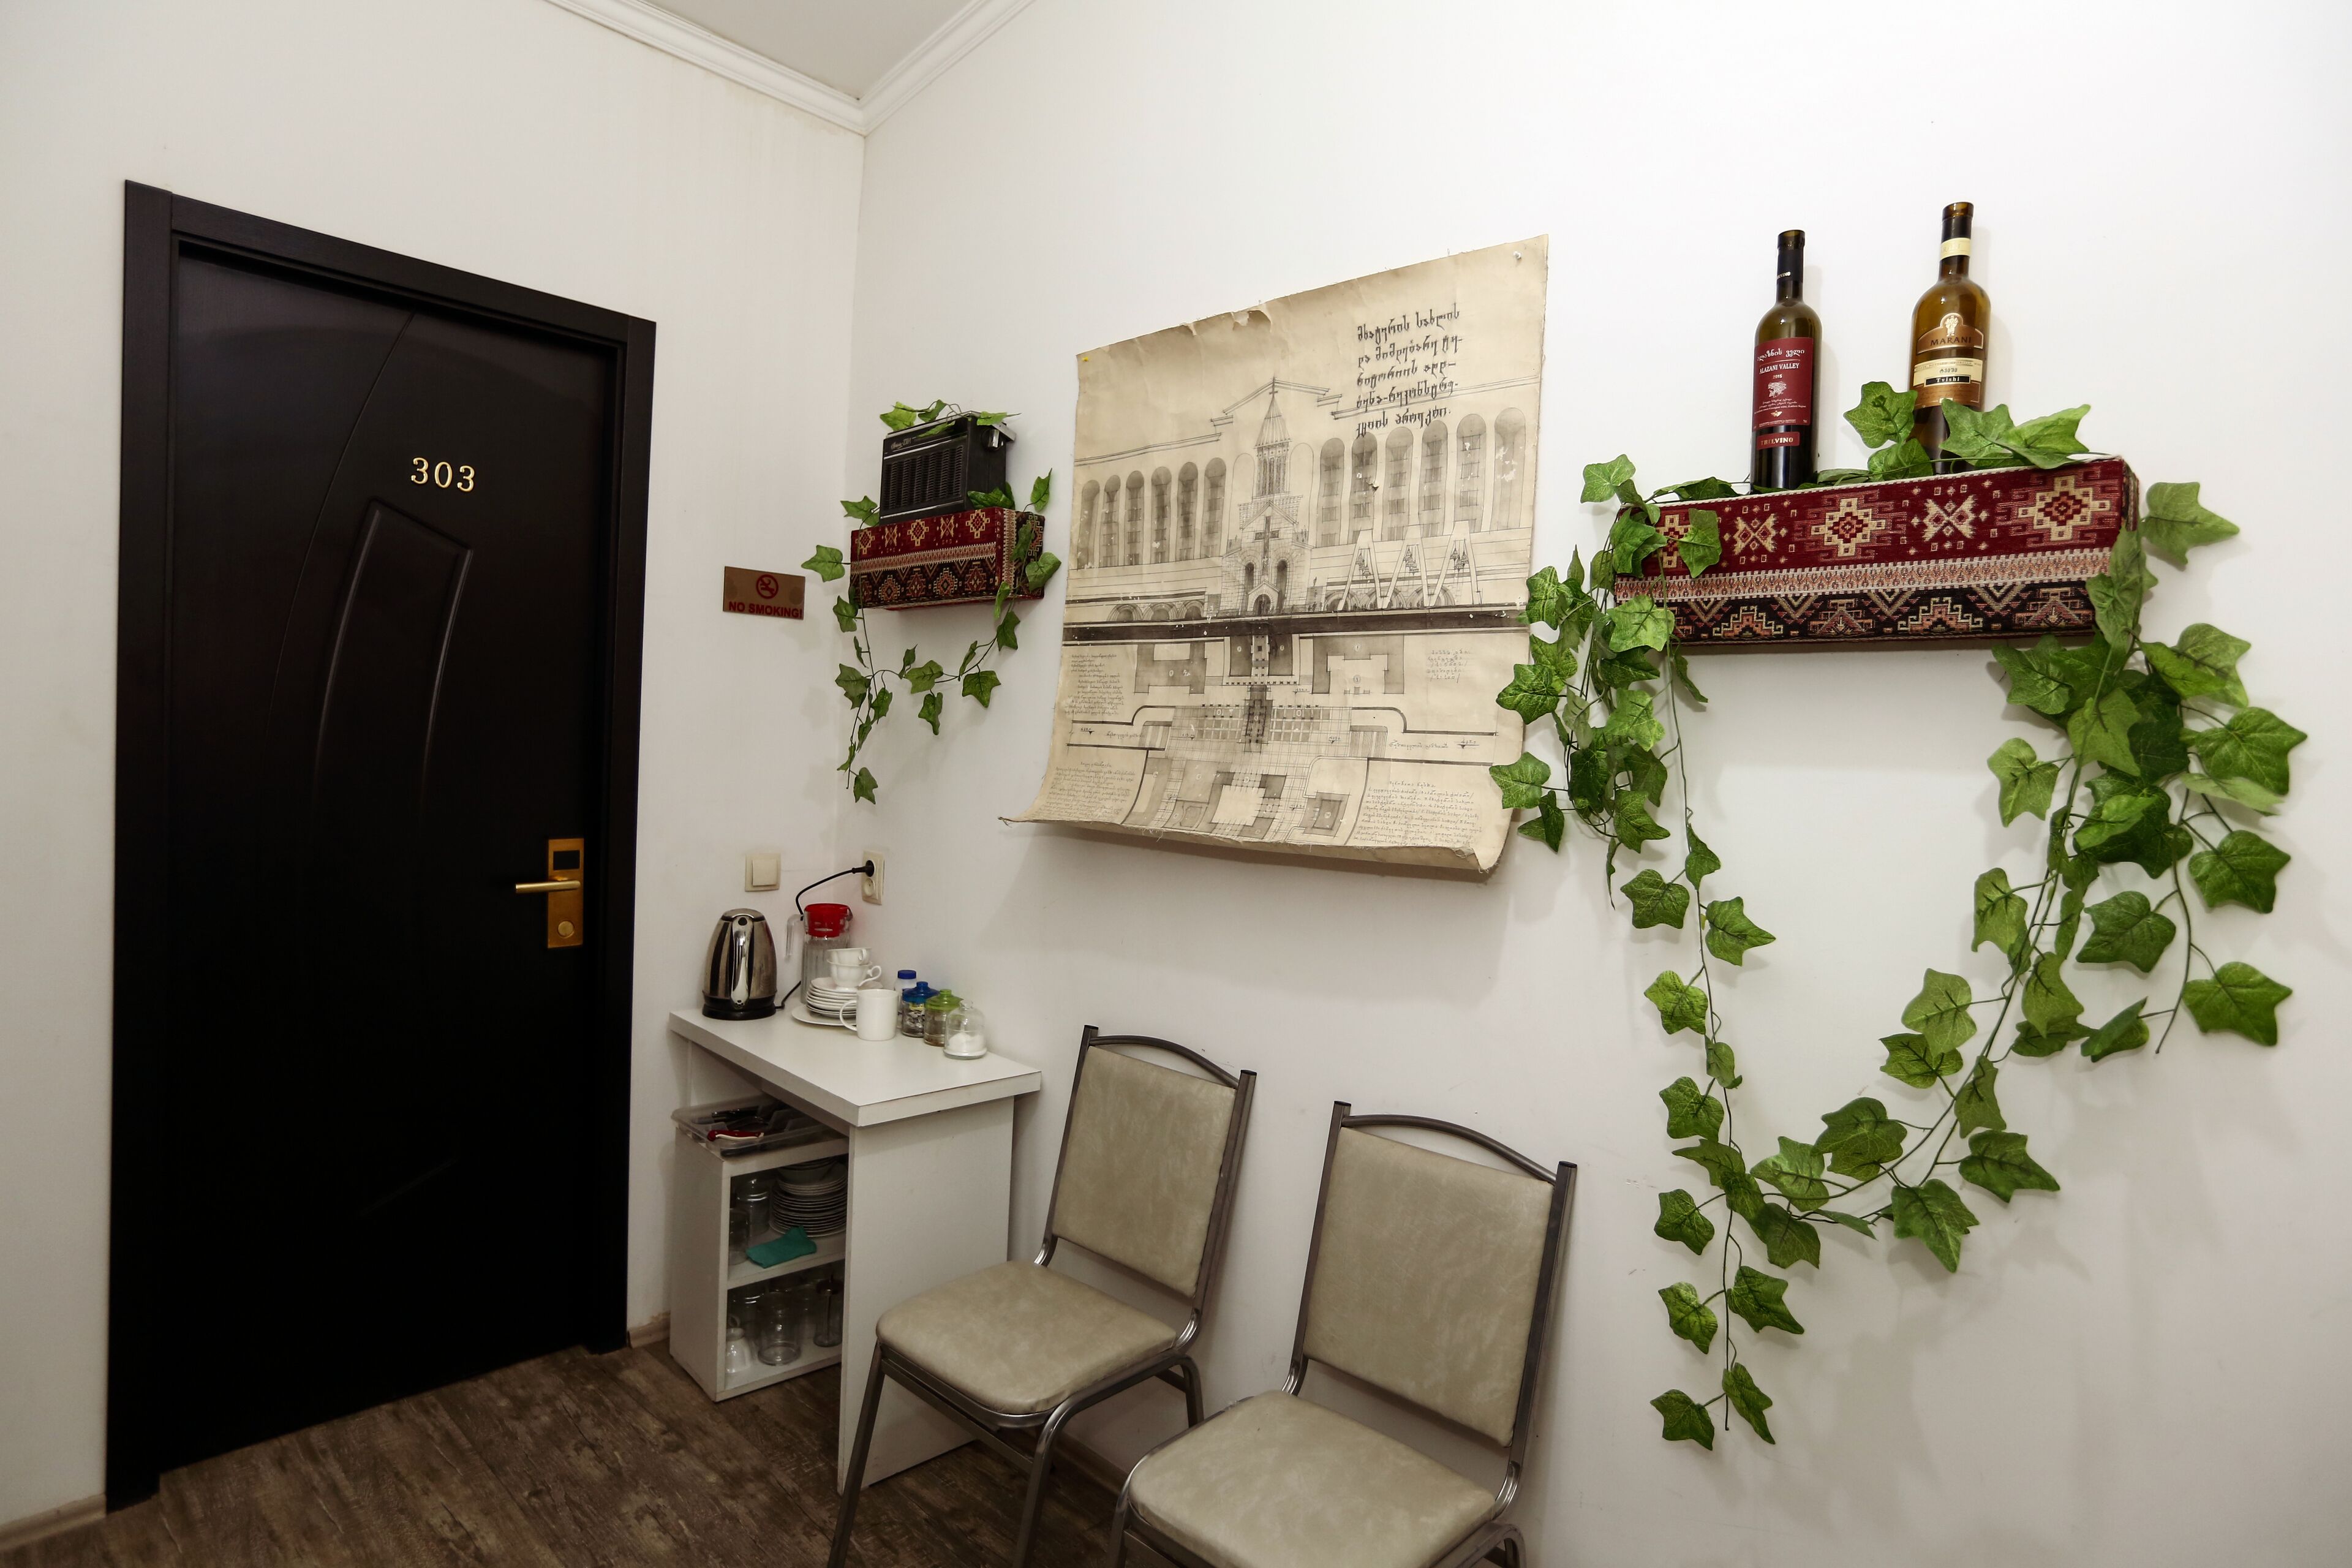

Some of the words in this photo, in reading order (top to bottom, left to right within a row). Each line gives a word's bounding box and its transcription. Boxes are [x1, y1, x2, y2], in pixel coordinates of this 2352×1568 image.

[1931, 337, 1972, 346] MARANI
[1358, 355, 1370, 371] და
[1759, 364, 1778, 374] ALAZANI
[411, 457, 475, 492] 303
[728, 601, 745, 612] NO
[748, 603, 802, 619] SMOKING!
